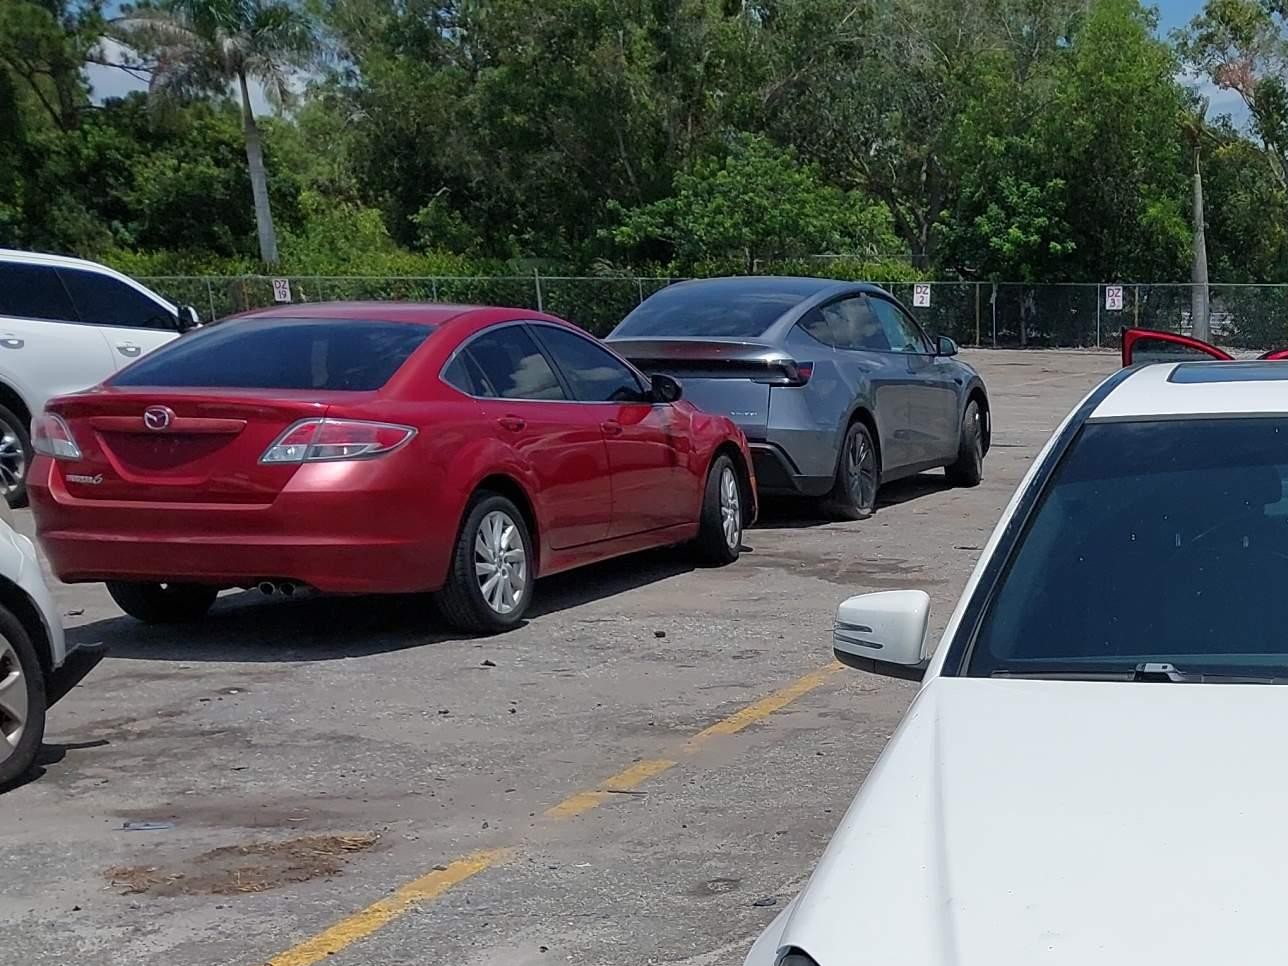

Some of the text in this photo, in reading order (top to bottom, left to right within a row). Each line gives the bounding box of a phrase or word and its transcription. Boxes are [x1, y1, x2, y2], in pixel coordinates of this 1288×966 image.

[274, 280, 287, 290] DZ
[278, 290, 287, 299] 19
[915, 286, 929, 295] DZ
[1107, 288, 1121, 298] DZ
[919, 295, 925, 304] 2
[1110, 298, 1116, 307] 3
